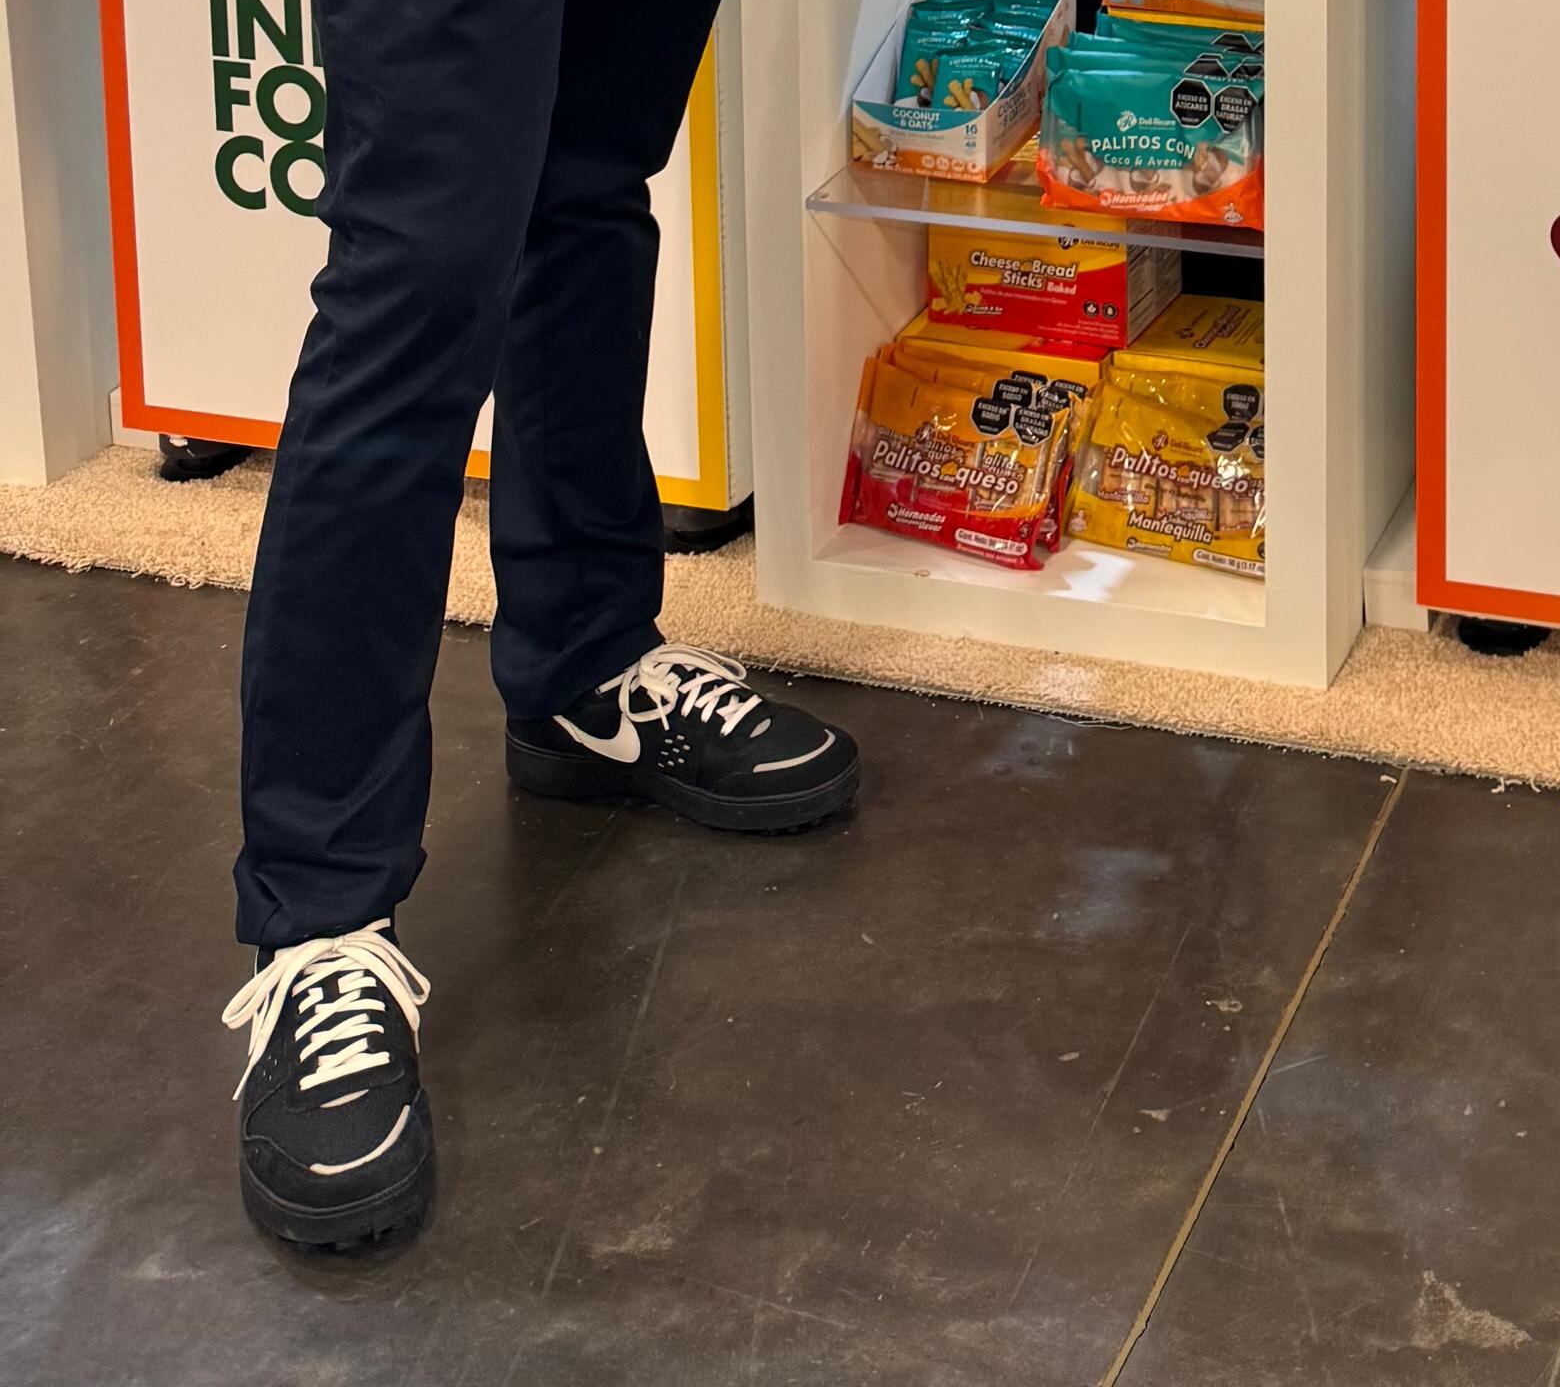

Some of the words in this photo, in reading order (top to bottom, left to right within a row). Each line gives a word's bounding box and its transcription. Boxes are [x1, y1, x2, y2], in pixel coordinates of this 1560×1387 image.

[892, 108, 940, 122] COCONUT
[1091, 135, 1162, 153] PALITOS
[1165, 137, 1196, 160] CON
[1103, 153, 1131, 166] Coco
[970, 251, 1021, 271] Cheese
[1031, 259, 1077, 279] Bread
[1002, 270, 1044, 289] Sticks
[1046, 280, 1077, 295] Baked
[872, 439, 942, 478] Palitos
[955, 465, 1019, 495] queso
[1111, 446, 1178, 479] Palitos
[1128, 511, 1213, 544] Mantequilla
